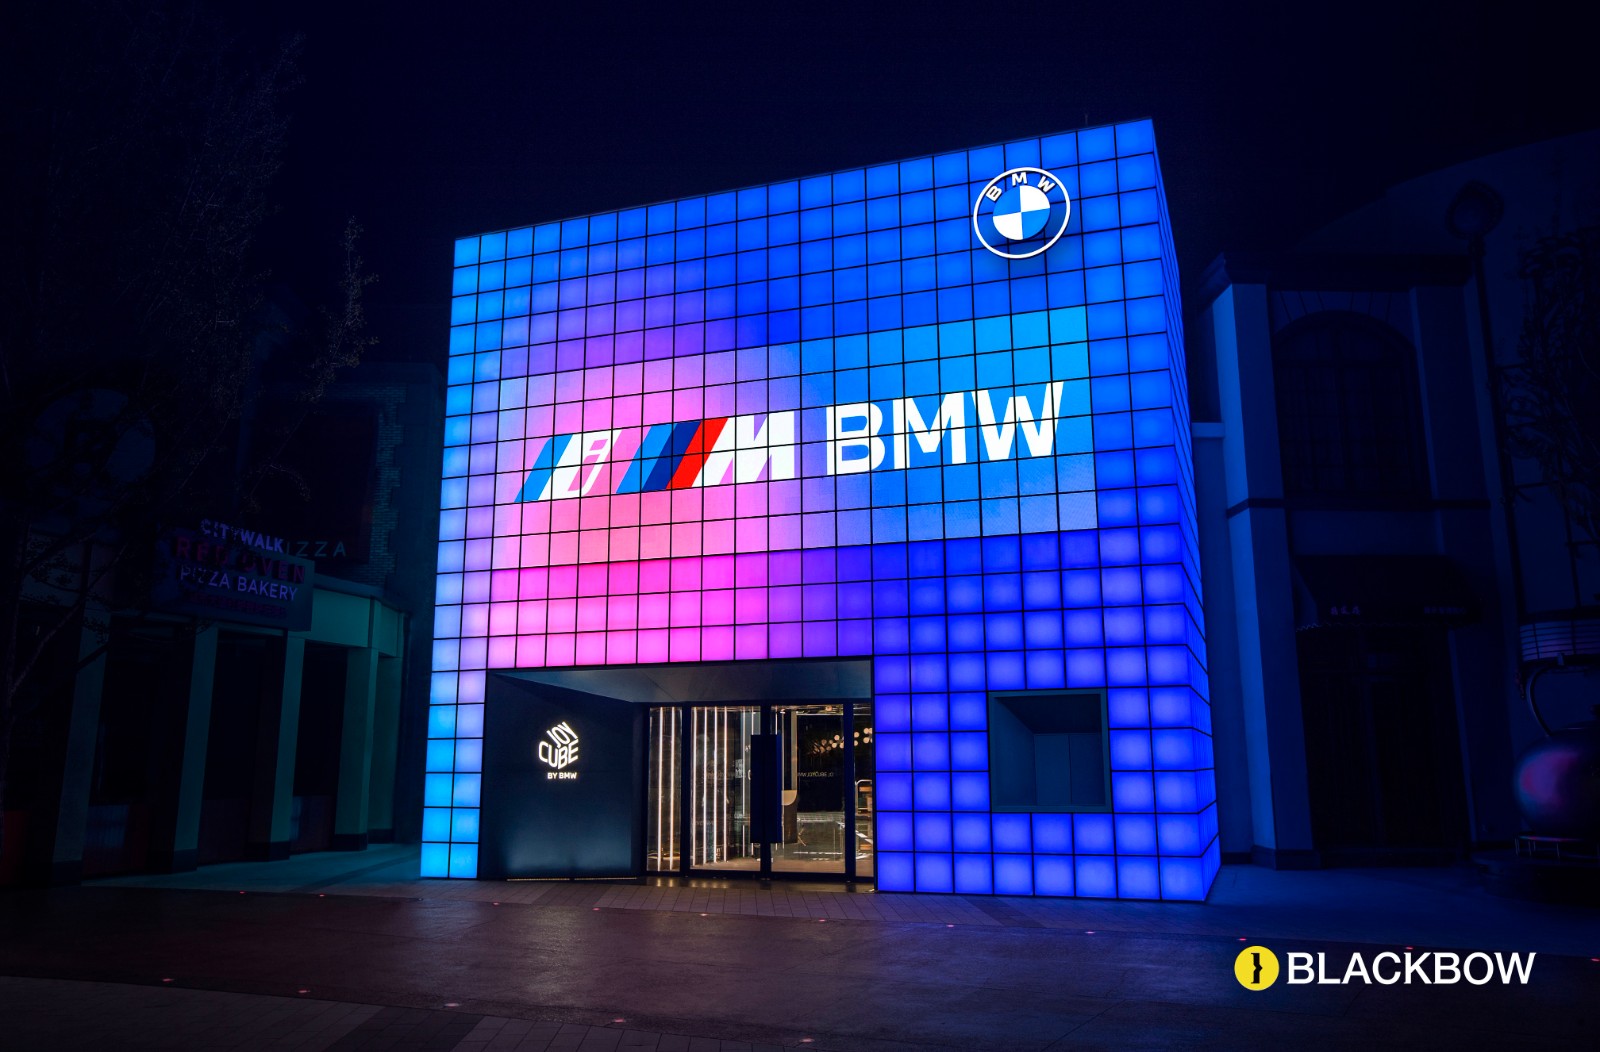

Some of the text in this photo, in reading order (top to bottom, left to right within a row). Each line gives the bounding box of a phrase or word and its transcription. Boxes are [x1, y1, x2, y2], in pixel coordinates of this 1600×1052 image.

[986, 172, 1055, 201] BMW
[826, 381, 1064, 475] BMW
[287, 540, 347, 558] IZZA
[237, 575, 299, 601] BAKERY
[546, 721, 579, 749] JOY
[538, 738, 579, 770] CUBE
